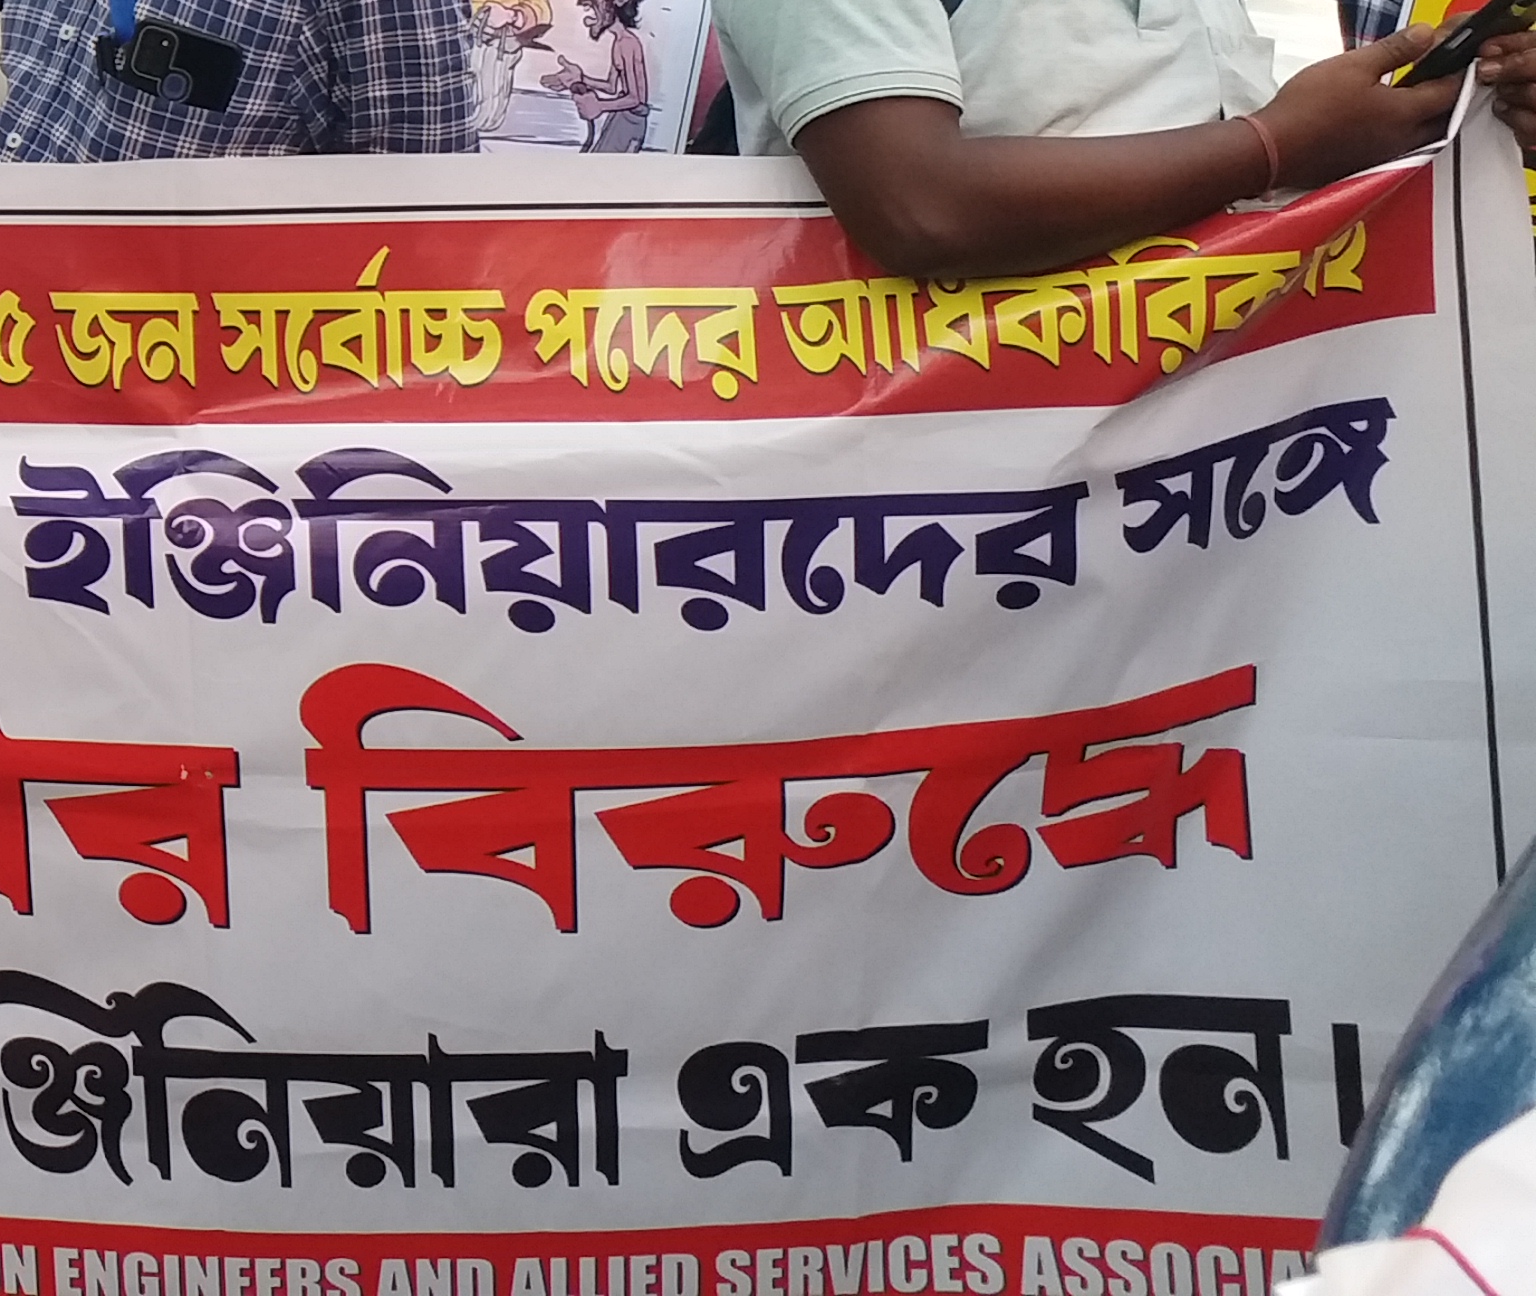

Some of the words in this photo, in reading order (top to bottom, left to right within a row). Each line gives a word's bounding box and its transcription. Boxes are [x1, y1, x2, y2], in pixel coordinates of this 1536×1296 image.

[48, 291, 199, 390] জন
[211, 245, 505, 394] সর্বোচ্চ
[525, 286, 760, 401] পদের
[9, 446, 1091, 633] ইঞ্জিনিয়ারদের
[1114, 396, 1397, 555] সঙ্গে
[299, 662, 1257, 935] বিরুদ্ধে
[678, 1019, 990, 1181] এক
[52, 1246, 363, 1296] ENGINEERS
[377, 1258, 495, 1296] AND
[509, 1254, 701, 1296] ALLIED
[715, 1233, 1006, 1296] SERVICES
[1021, 1235, 1320, 1296] ASSOCIA
